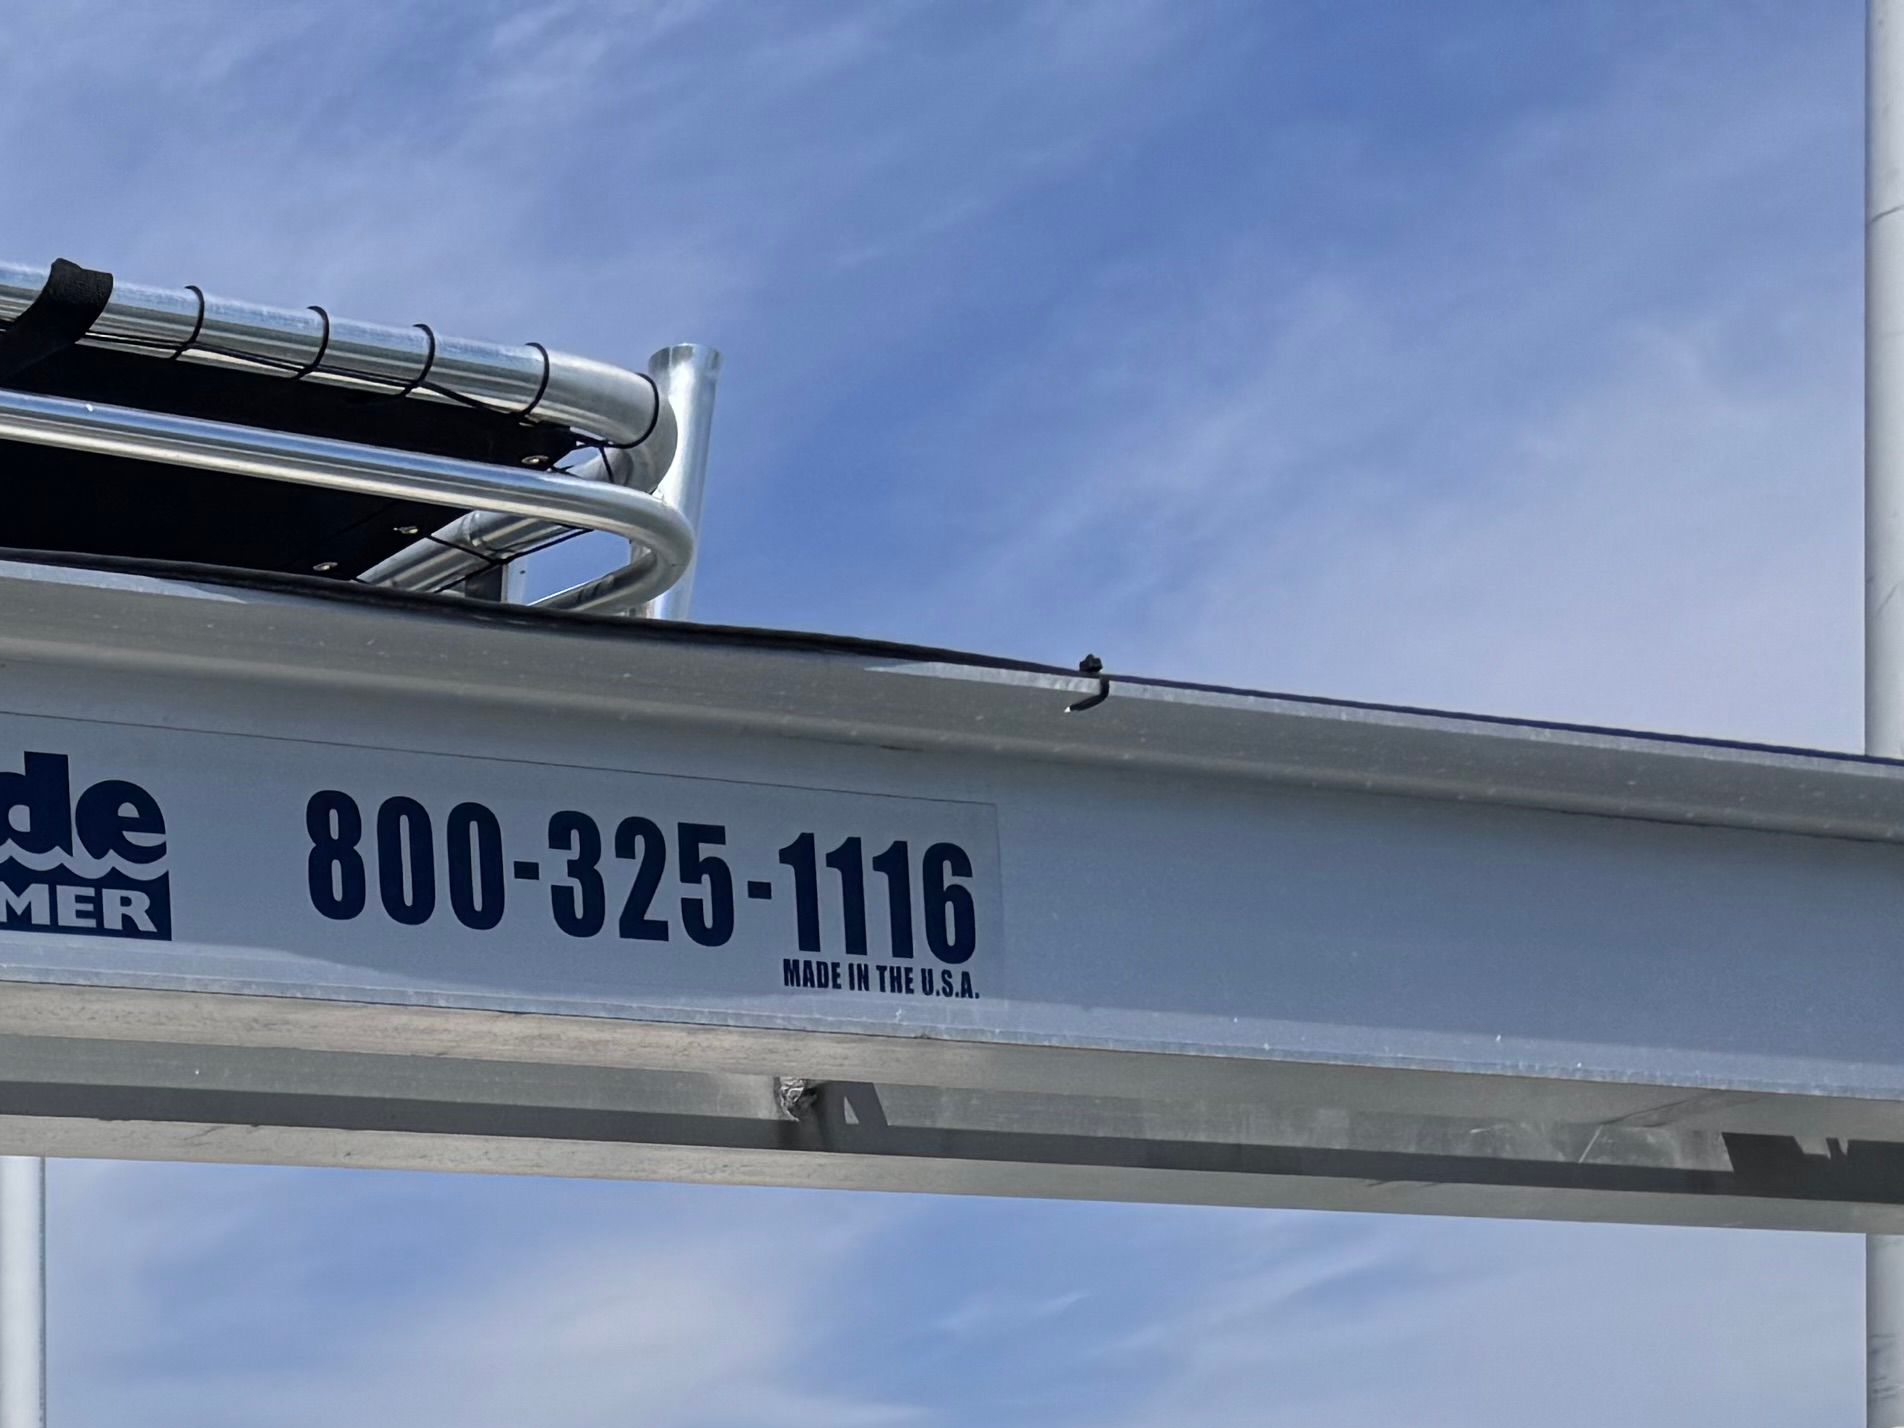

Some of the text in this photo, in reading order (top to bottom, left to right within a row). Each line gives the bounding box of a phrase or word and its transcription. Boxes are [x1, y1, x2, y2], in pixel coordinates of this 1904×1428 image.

[305, 788, 976, 965] 800-325-1116
[783, 958, 980, 999] MADE IN THE U.S.A.
